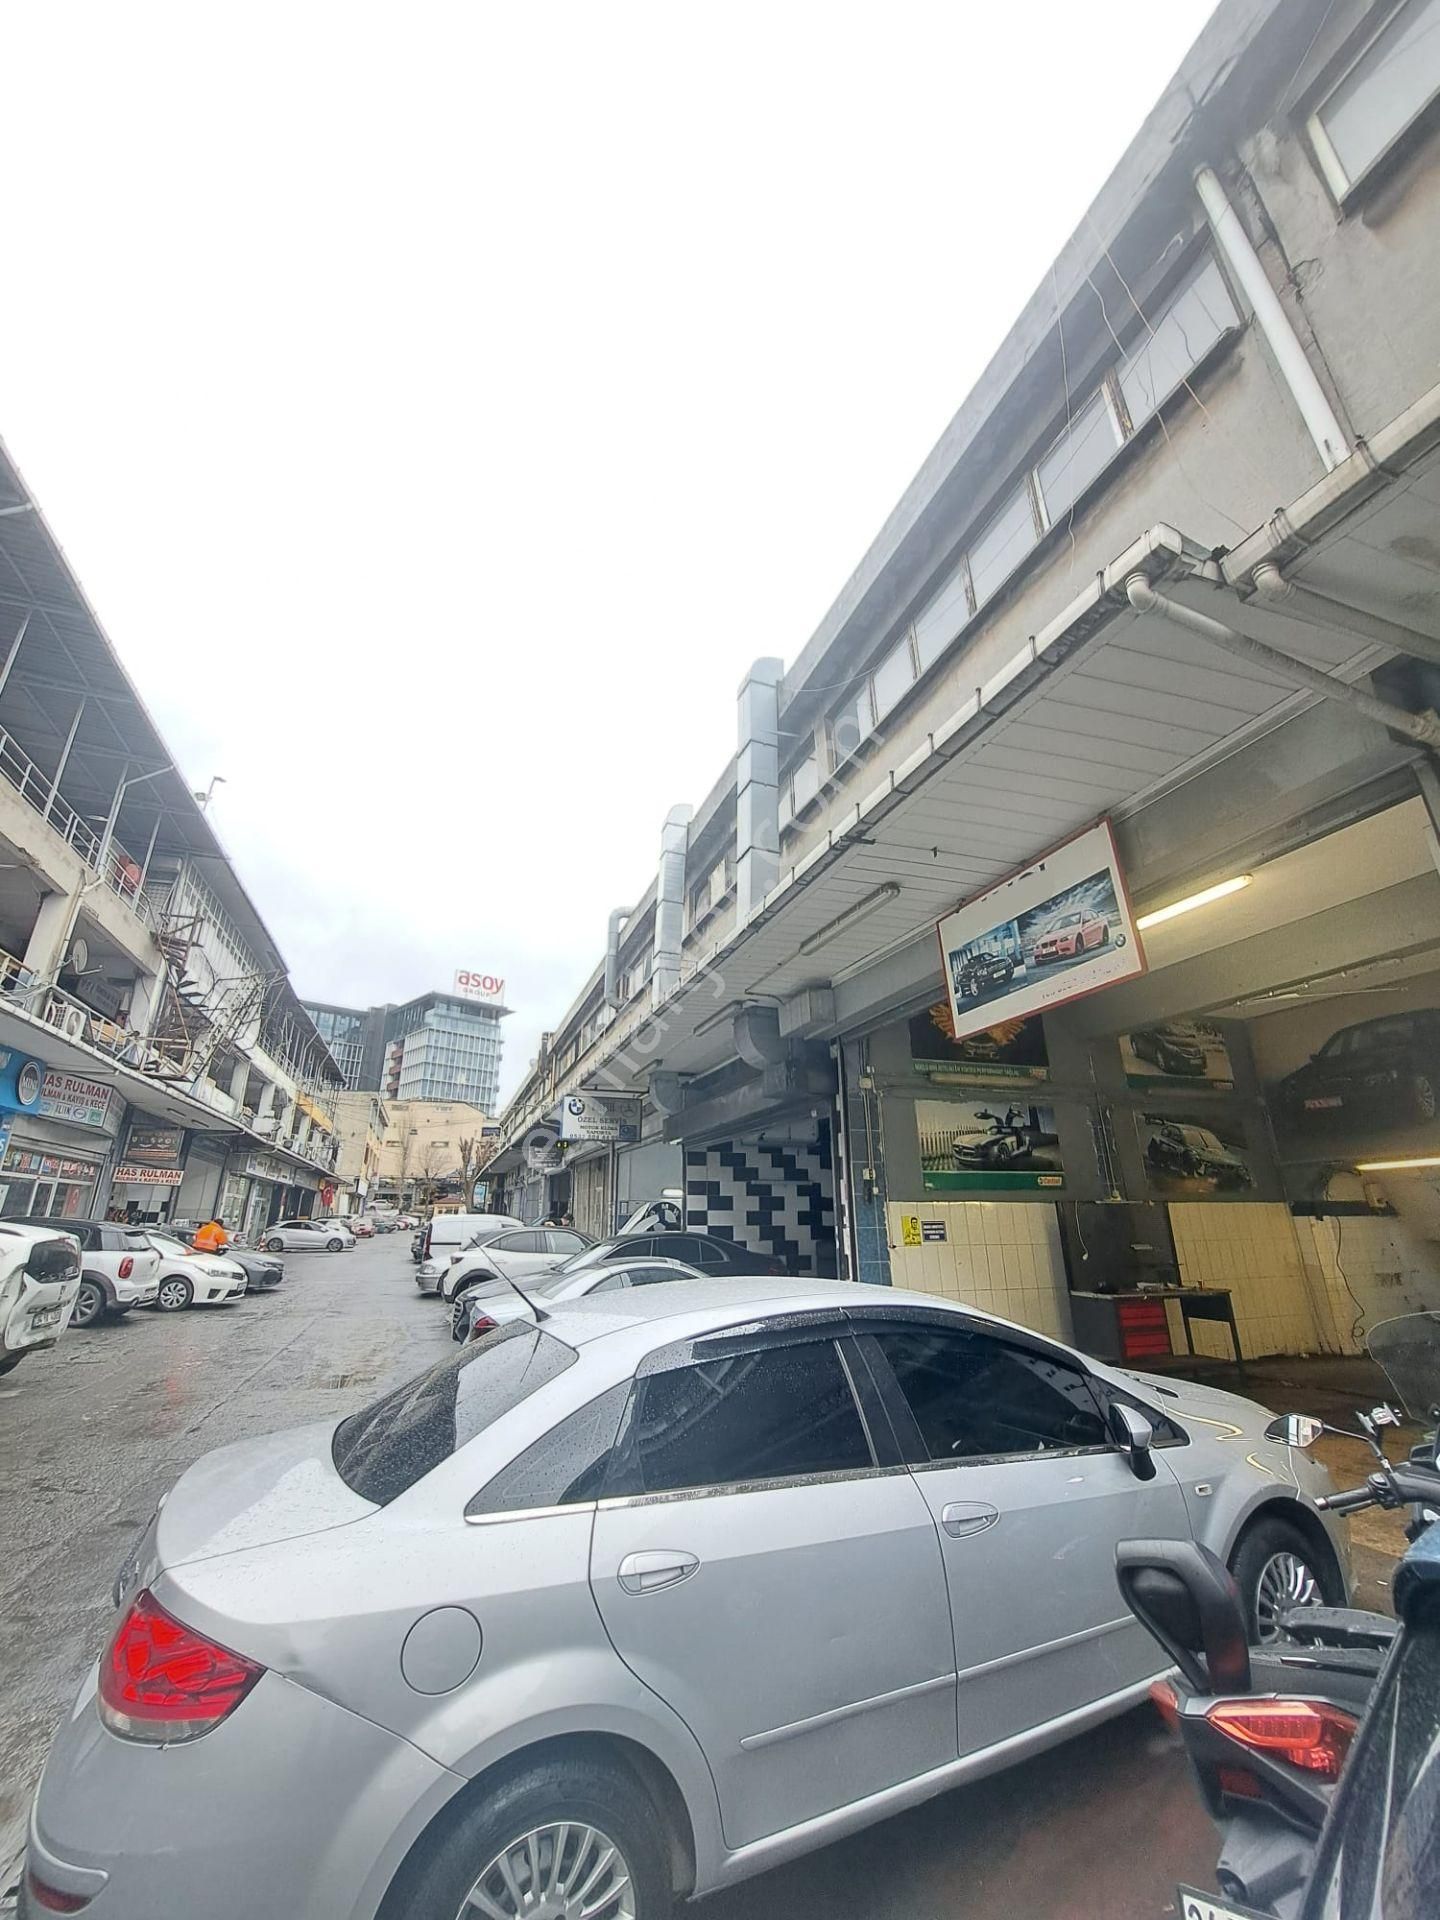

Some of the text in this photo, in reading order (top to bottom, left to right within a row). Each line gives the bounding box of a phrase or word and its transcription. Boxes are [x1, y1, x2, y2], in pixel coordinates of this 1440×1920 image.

[458, 970, 504, 995] asoy
[463, 987, 490, 997] GROUP
[64, 1078, 110, 1099] RULMAN
[116, 1167, 182, 1179] HAS RULMAN
